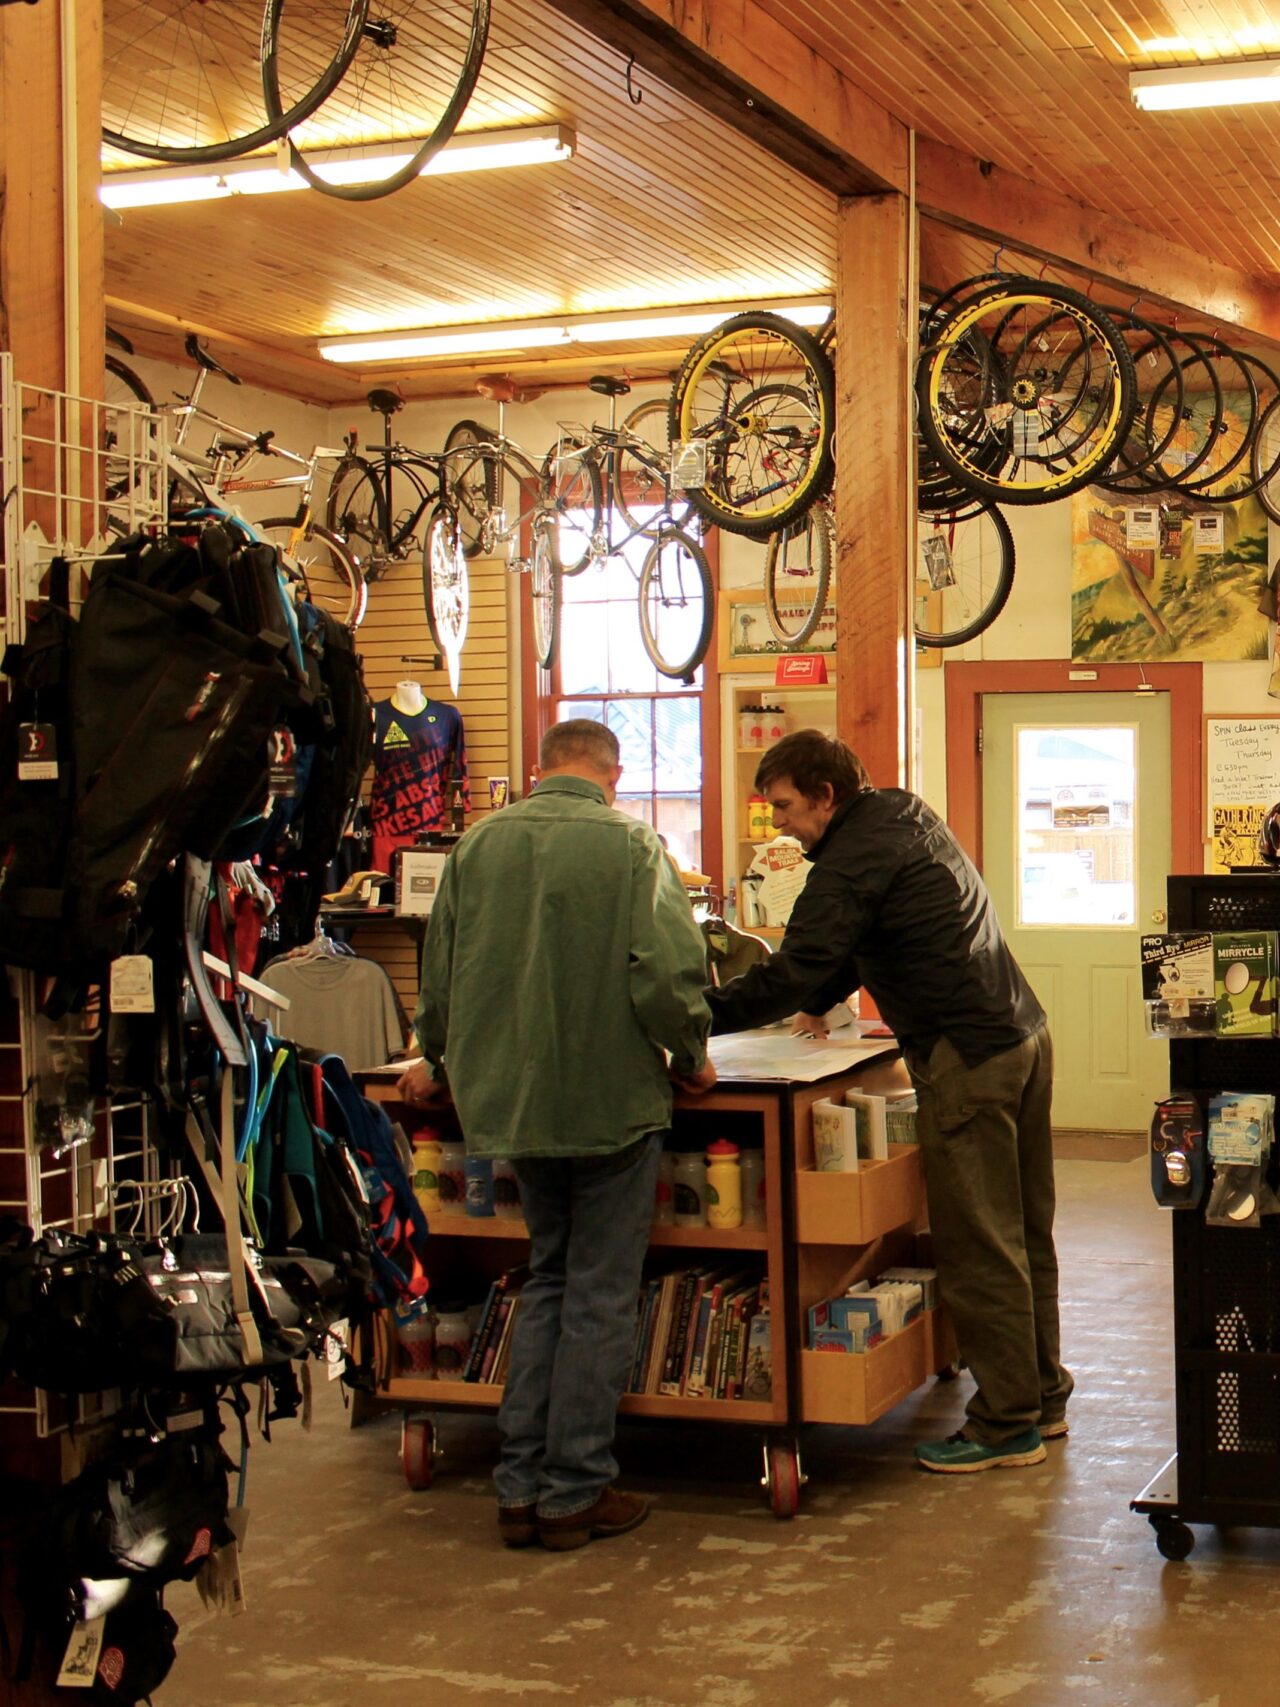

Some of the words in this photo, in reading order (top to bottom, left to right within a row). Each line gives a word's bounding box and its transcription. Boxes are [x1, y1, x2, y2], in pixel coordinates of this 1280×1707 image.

[1214, 725, 1232, 737] SPIN
[1234, 724, 1256, 733] class
[1220, 738, 1259, 751] Tuesday
[1234, 750, 1272, 761] Thursday
[1214, 809, 1265, 825] GATHERING
[1143, 937, 1162, 947] PRO
[1143, 947, 1165, 960] Third
[1165, 944, 1182, 955] Eye
[1183, 936, 1210, 949] MIRROR
[1217, 947, 1265, 958] MIRRYCLE
